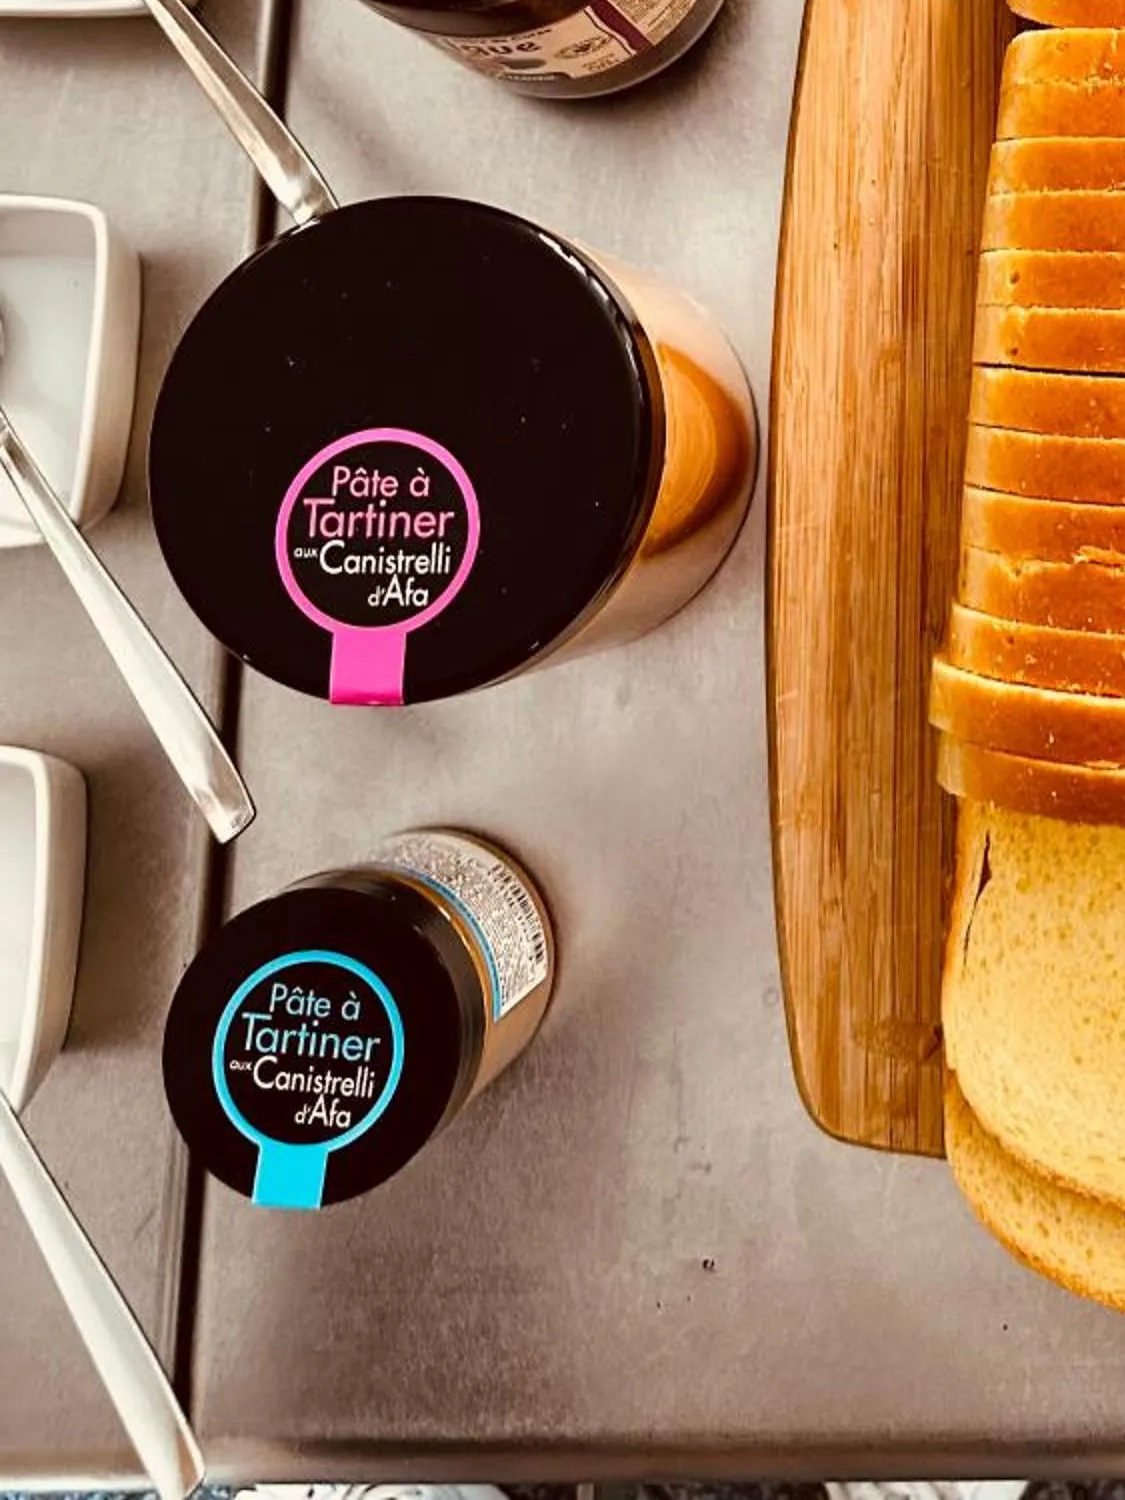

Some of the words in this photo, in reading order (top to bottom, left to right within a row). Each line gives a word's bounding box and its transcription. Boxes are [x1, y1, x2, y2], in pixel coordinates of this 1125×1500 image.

[332, 465, 399, 497] Pâte
[409, 467, 430, 497] à
[303, 498, 455, 539] Tartiner
[294, 547, 319, 558] aux
[319, 539, 452, 575] Canistrelli
[367, 573, 429, 607] d'Afa
[269, 983, 331, 1019] Pâte
[341, 992, 361, 1021] à
[241, 1012, 381, 1062] Tartiner
[229, 1059, 253, 1072] aux
[252, 1055, 376, 1099] Canistrelli
[294, 1094, 353, 1129] d'Afa
